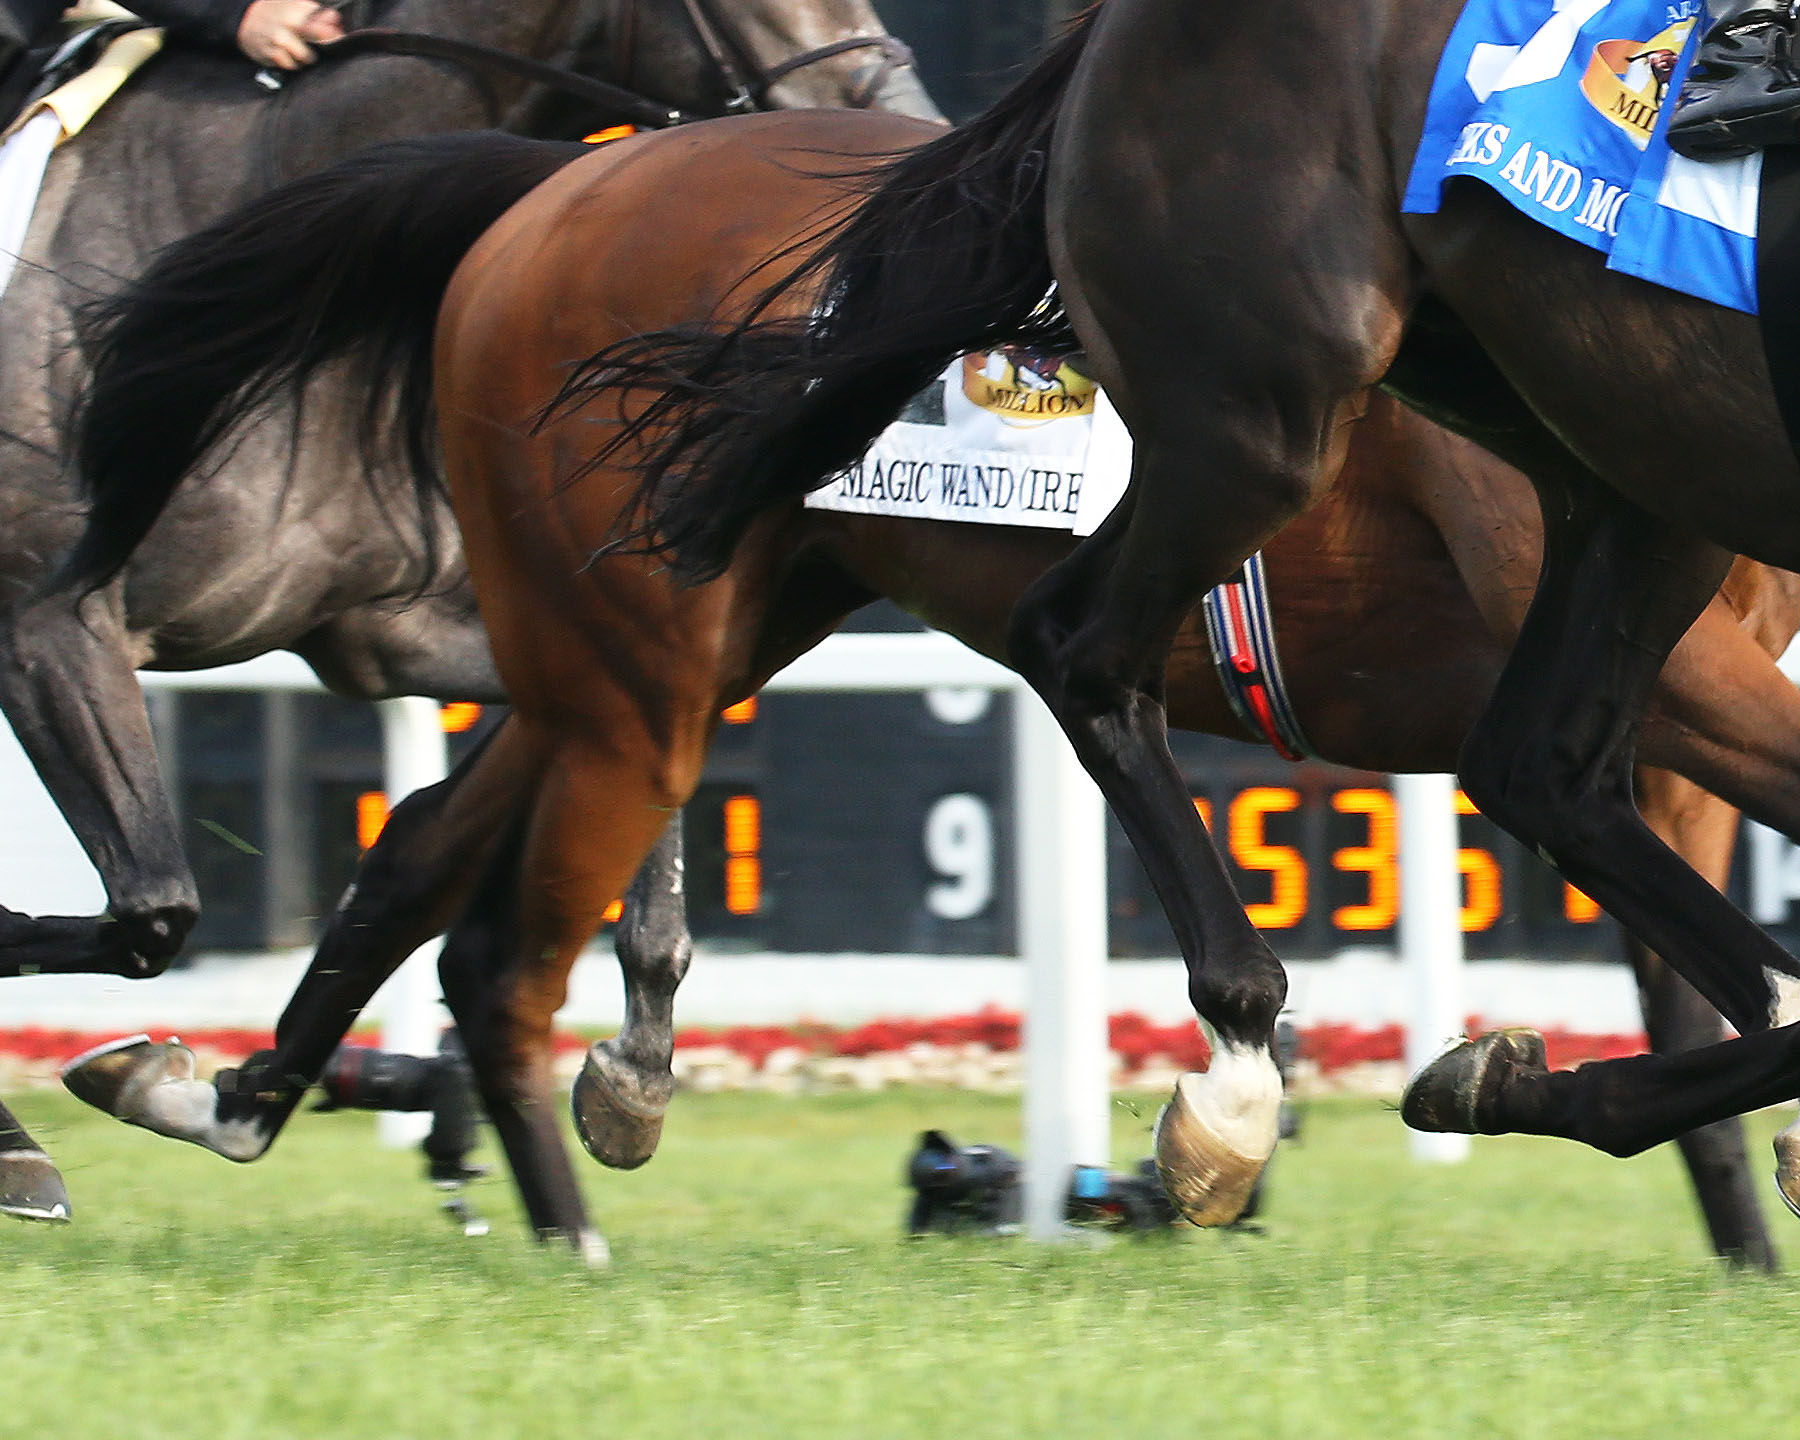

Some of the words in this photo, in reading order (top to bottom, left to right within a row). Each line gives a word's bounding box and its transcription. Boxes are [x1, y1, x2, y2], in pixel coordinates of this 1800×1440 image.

[1499, 141, 1582, 212] AND
[986, 385, 1089, 414] MILLION
[840, 458, 933, 503] MAGIC
[941, 463, 1014, 509] WAND
[924, 793, 993, 921] 9
